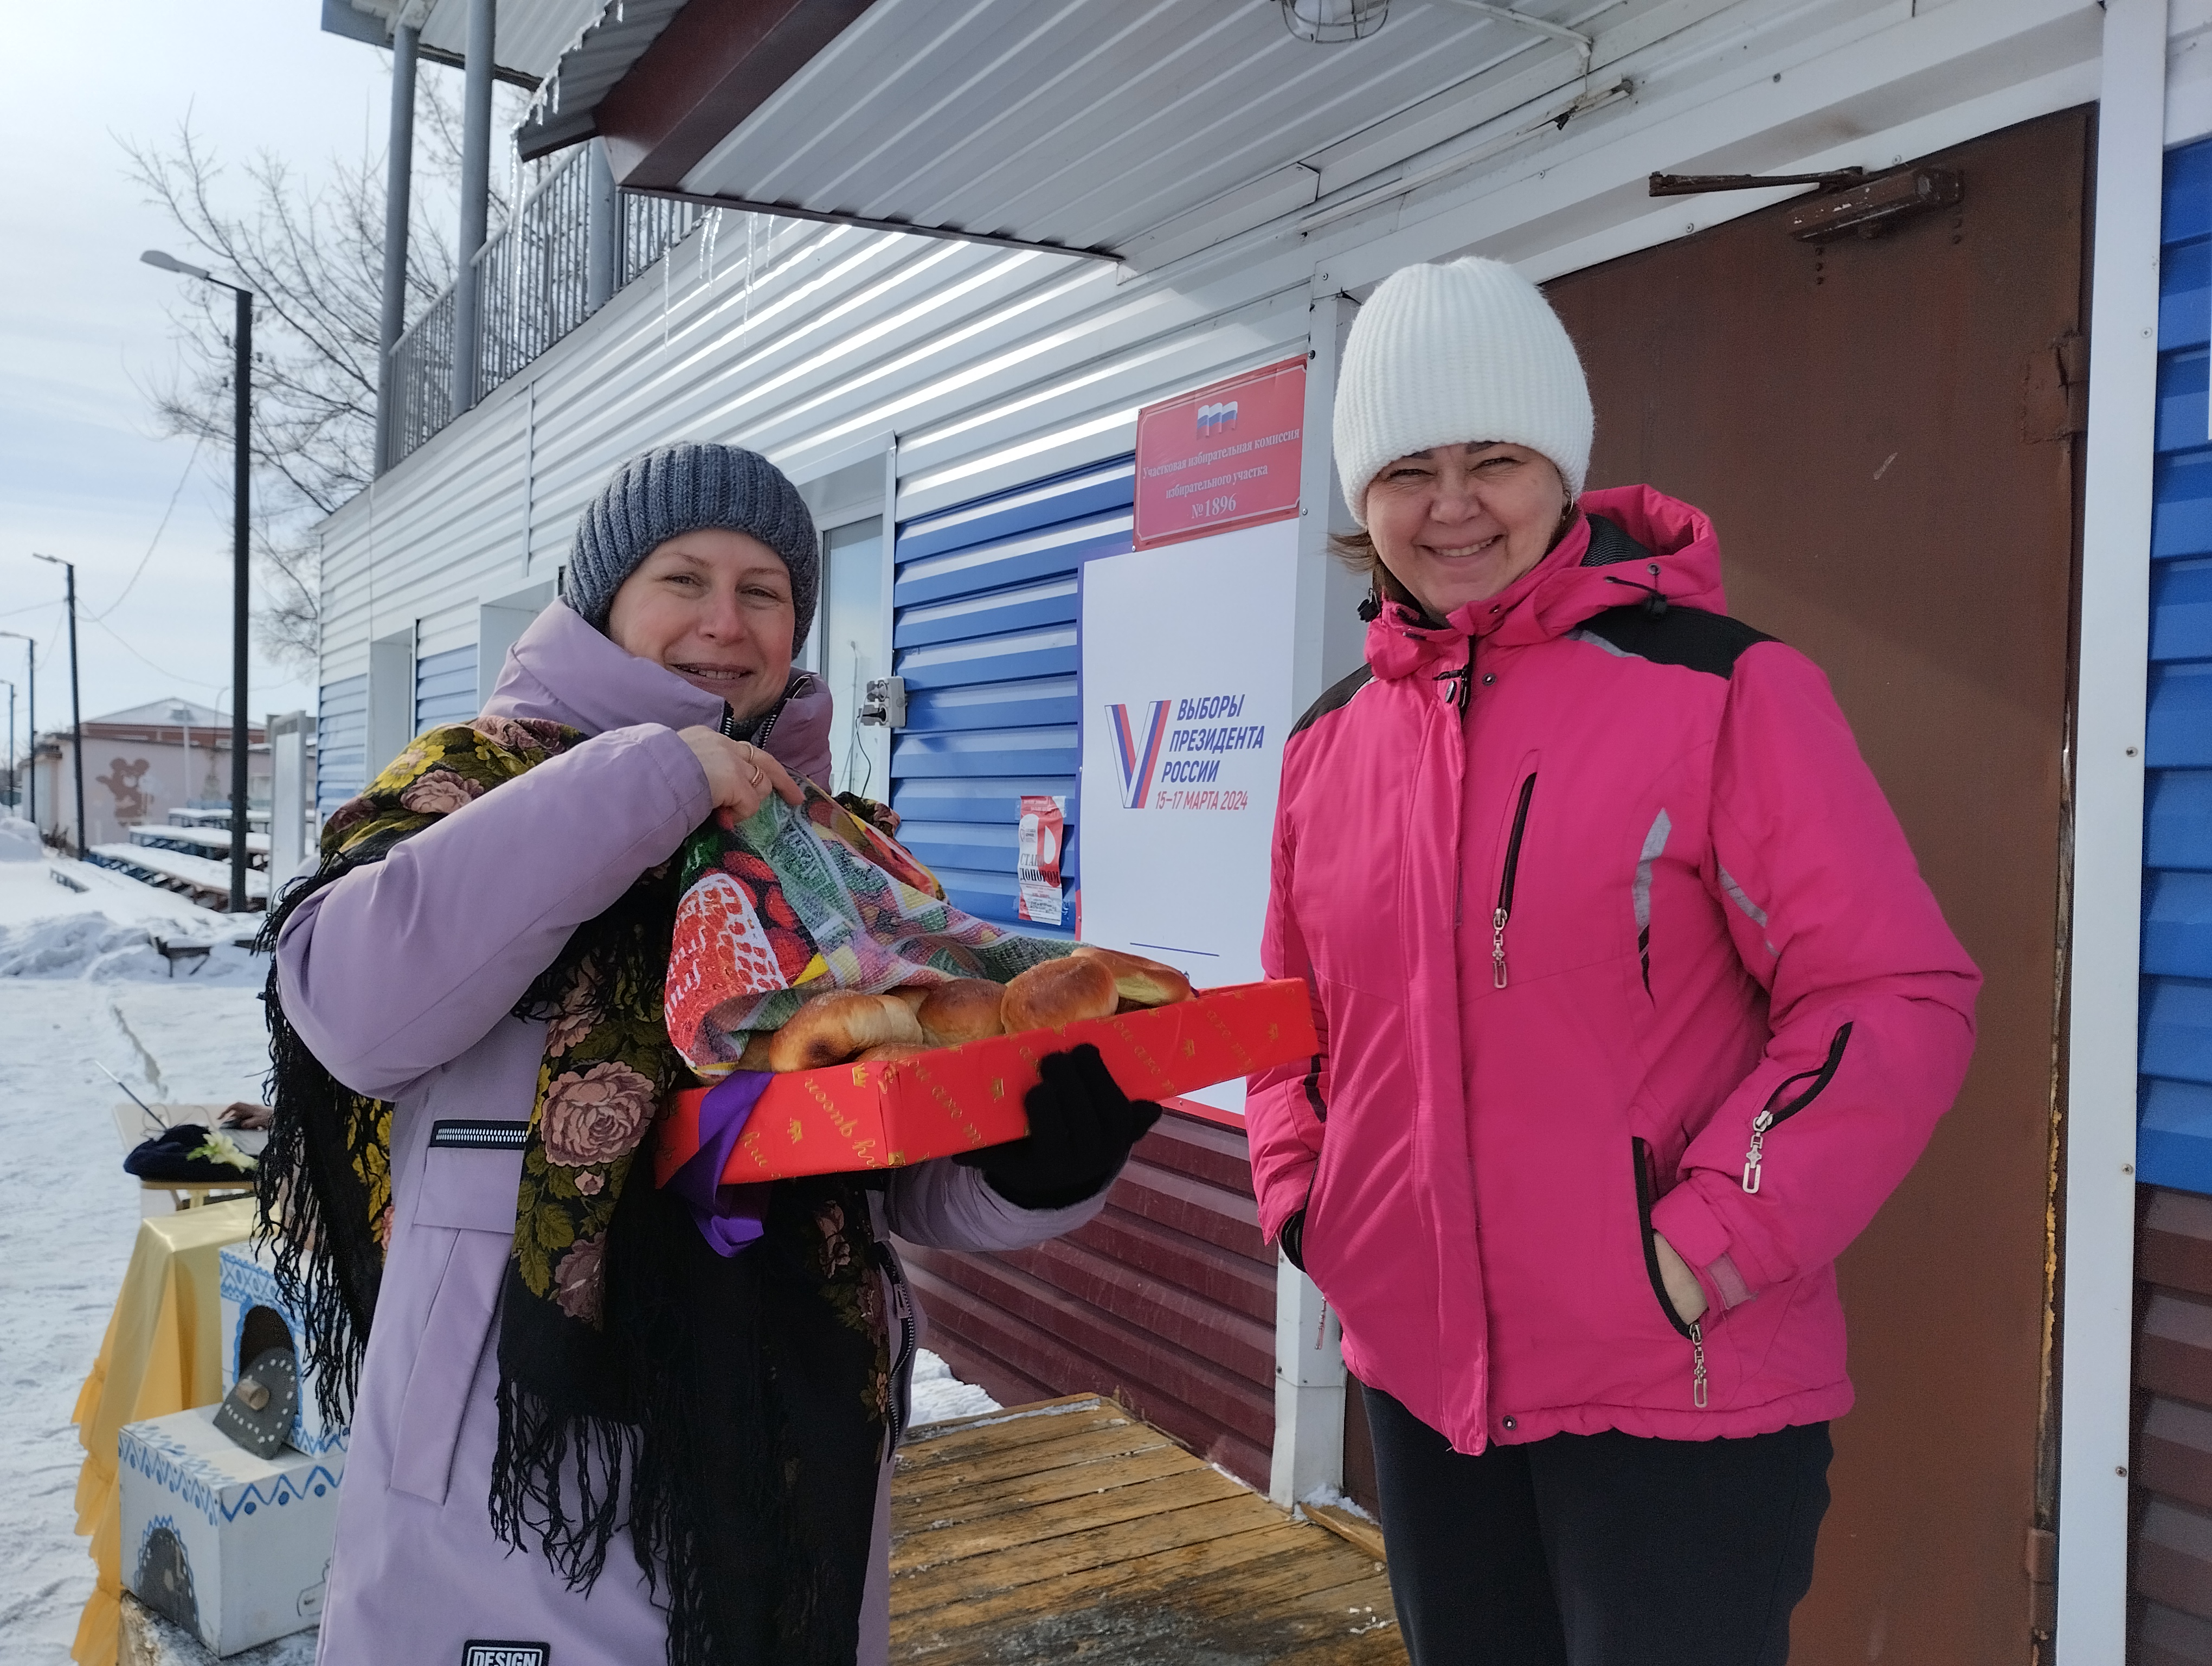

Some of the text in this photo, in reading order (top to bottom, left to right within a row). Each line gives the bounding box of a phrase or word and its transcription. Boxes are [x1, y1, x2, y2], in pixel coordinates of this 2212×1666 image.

[1143, 428, 1300, 479] Участковая избирательная комиссия
[1166, 465, 1268, 499] избирательного участка
[1176, 694, 1245, 721] ВЫБОРЫ
[1168, 725, 1265, 754] ПРЕЗИДЕНТА
[1161, 760, 1221, 783] РОССИИ
[1182, 790, 1219, 810] МАРТА
[1220, 790, 1249, 810] 2024
[473, 1651, 537, 1666] DESIGN
